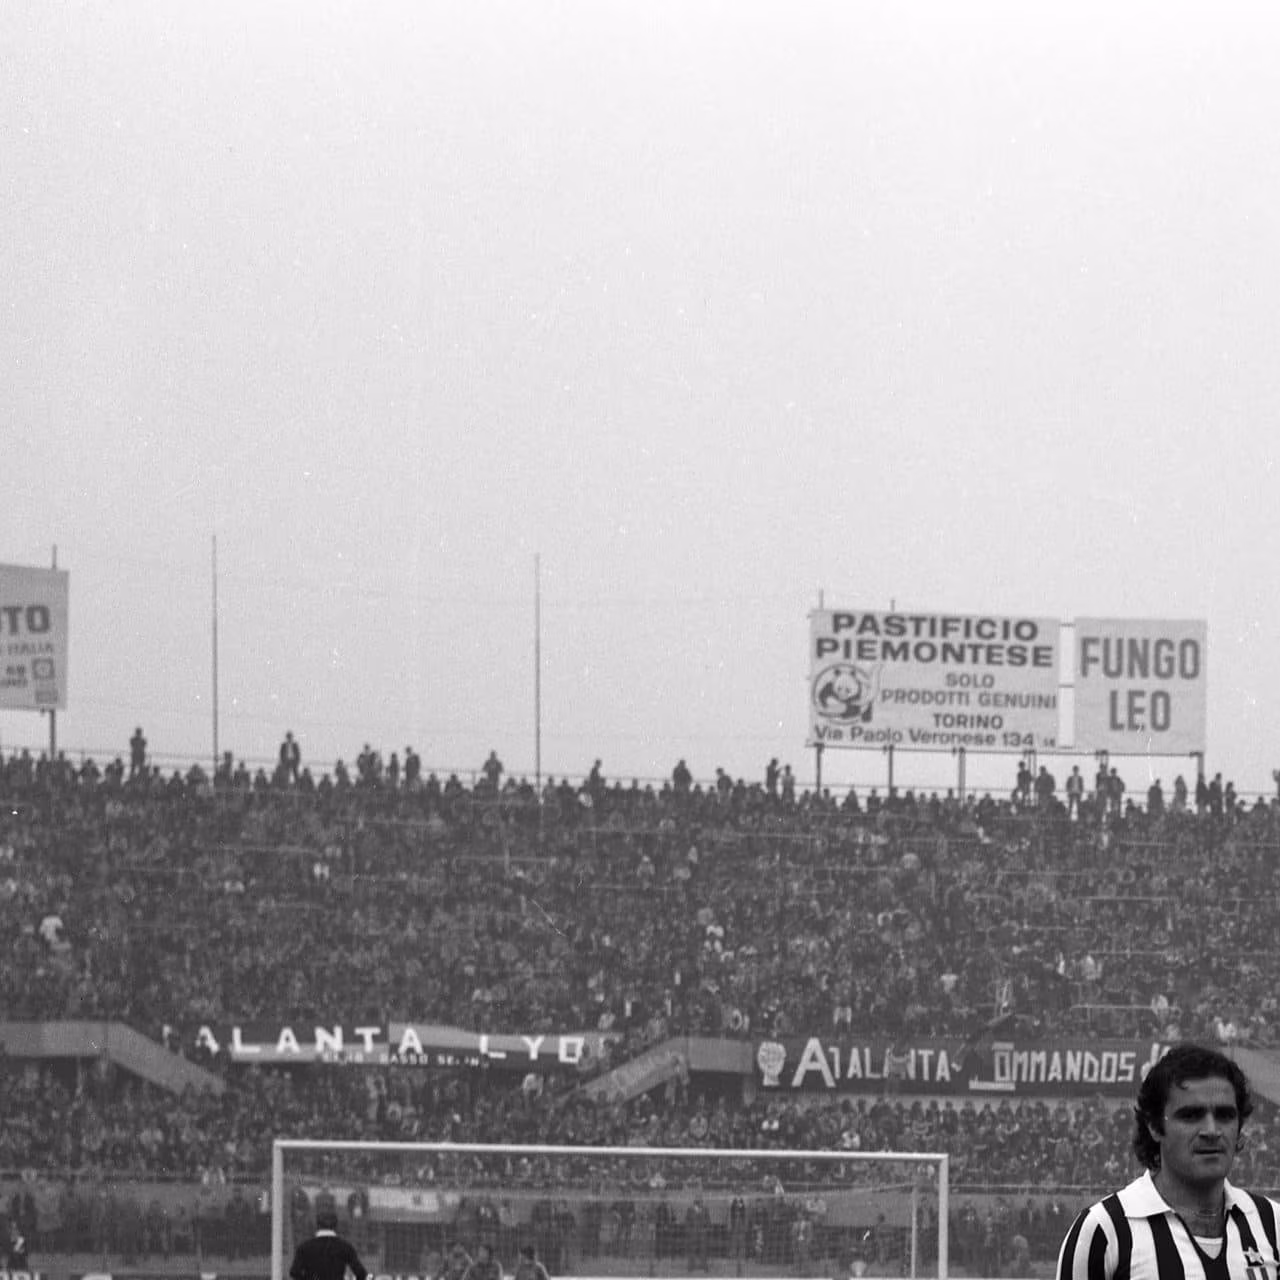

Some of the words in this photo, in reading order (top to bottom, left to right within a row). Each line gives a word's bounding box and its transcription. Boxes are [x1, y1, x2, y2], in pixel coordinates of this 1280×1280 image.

[832, 612, 1039, 641] PASTIFICIO
[815, 637, 1054, 668] PIEMONTESE
[1080, 636, 1201, 681] FUNGO
[945, 673, 995, 689] SOLO
[881, 689, 970, 707] PRODOTTI
[978, 692, 1057, 709] GENUINI
[1109, 689, 1172, 732] LEO
[933, 712, 1004, 729] TORINO
[813, 724, 843, 741] Via
[850, 726, 903, 743] Paolo
[909, 728, 996, 746] Veronese
